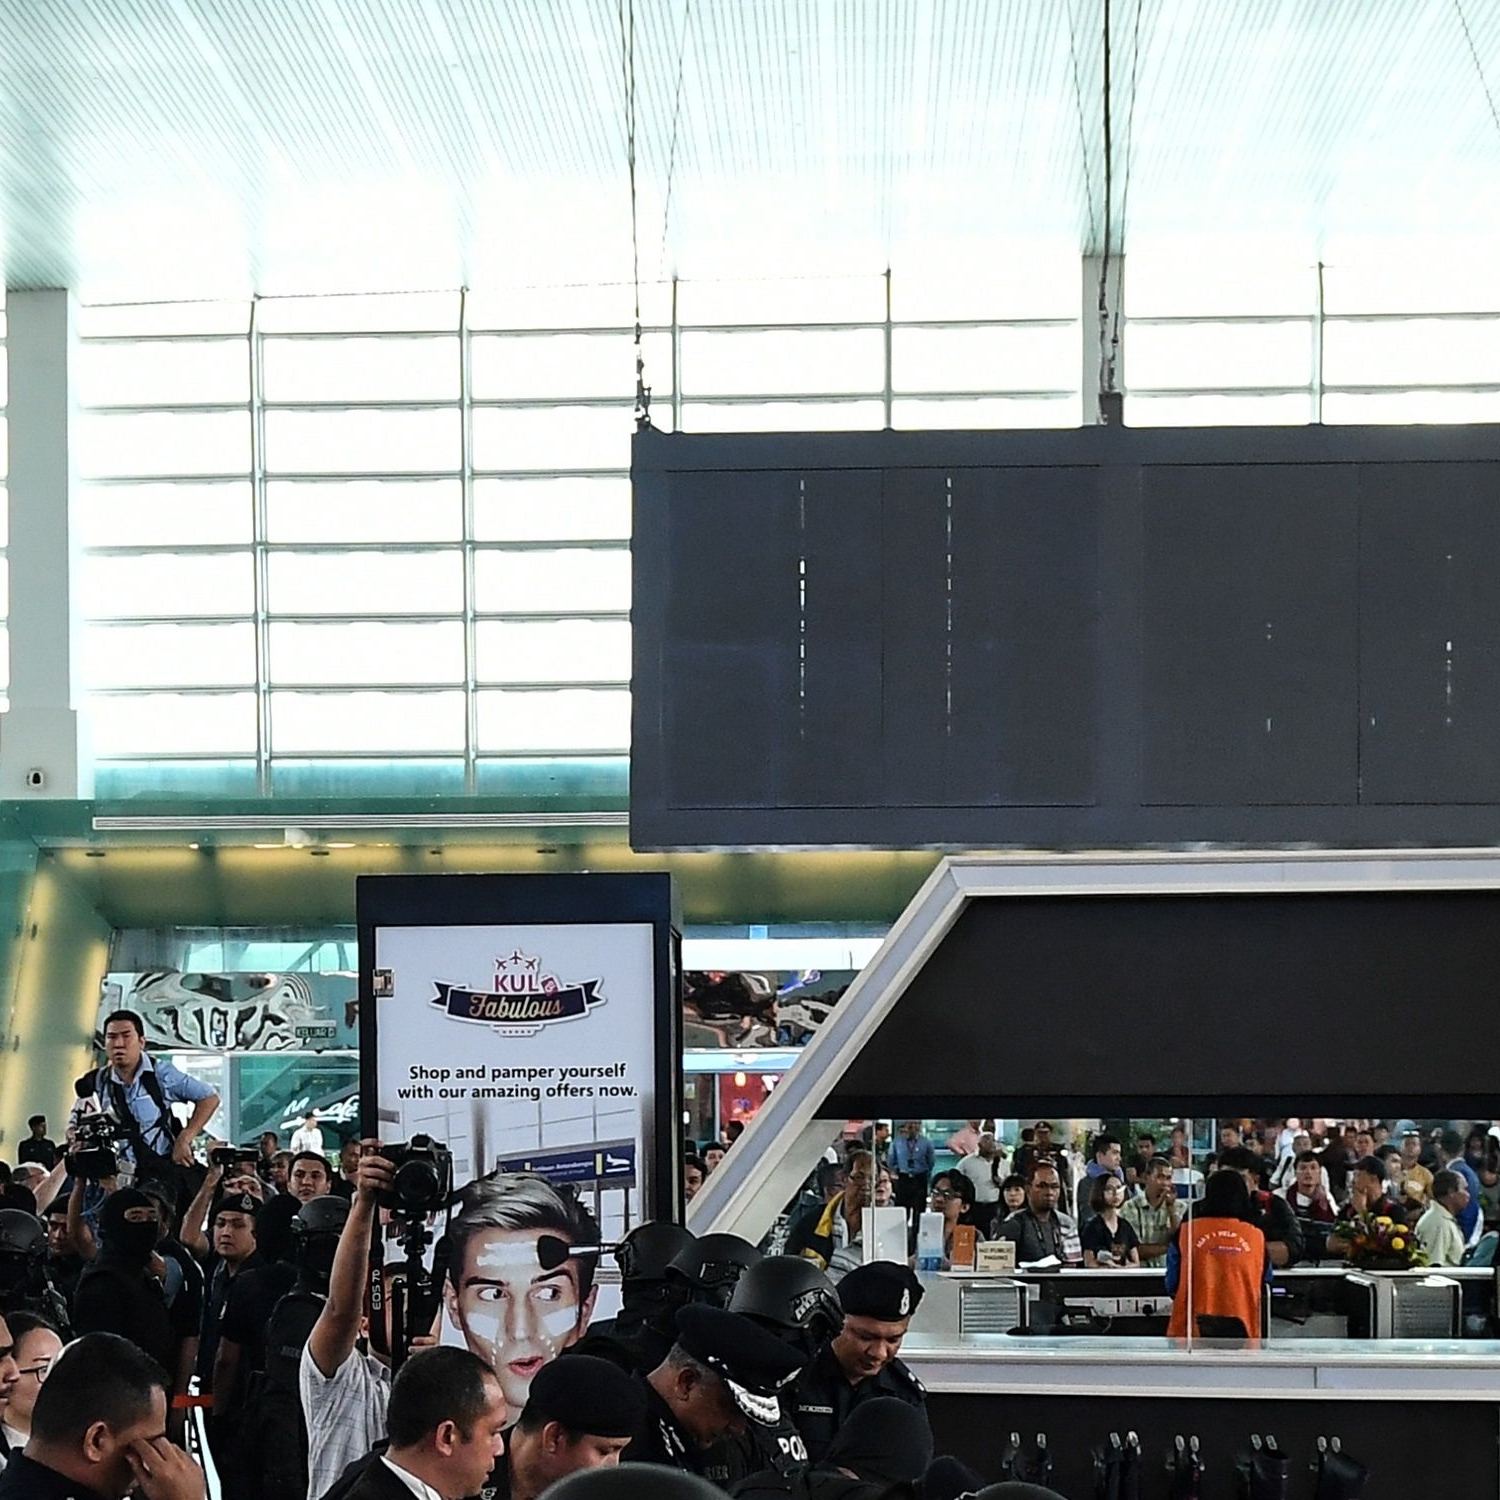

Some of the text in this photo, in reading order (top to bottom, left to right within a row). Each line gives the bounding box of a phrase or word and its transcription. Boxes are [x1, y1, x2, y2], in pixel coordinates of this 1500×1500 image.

[494, 974, 539, 993] KUL
[468, 992, 564, 1019] Fabulous
[409, 1063, 627, 1082] Shop and pamper yourself
[398, 1083, 638, 1101] with our amazing offers now.
[372, 1268, 382, 1311] EOS 7D
